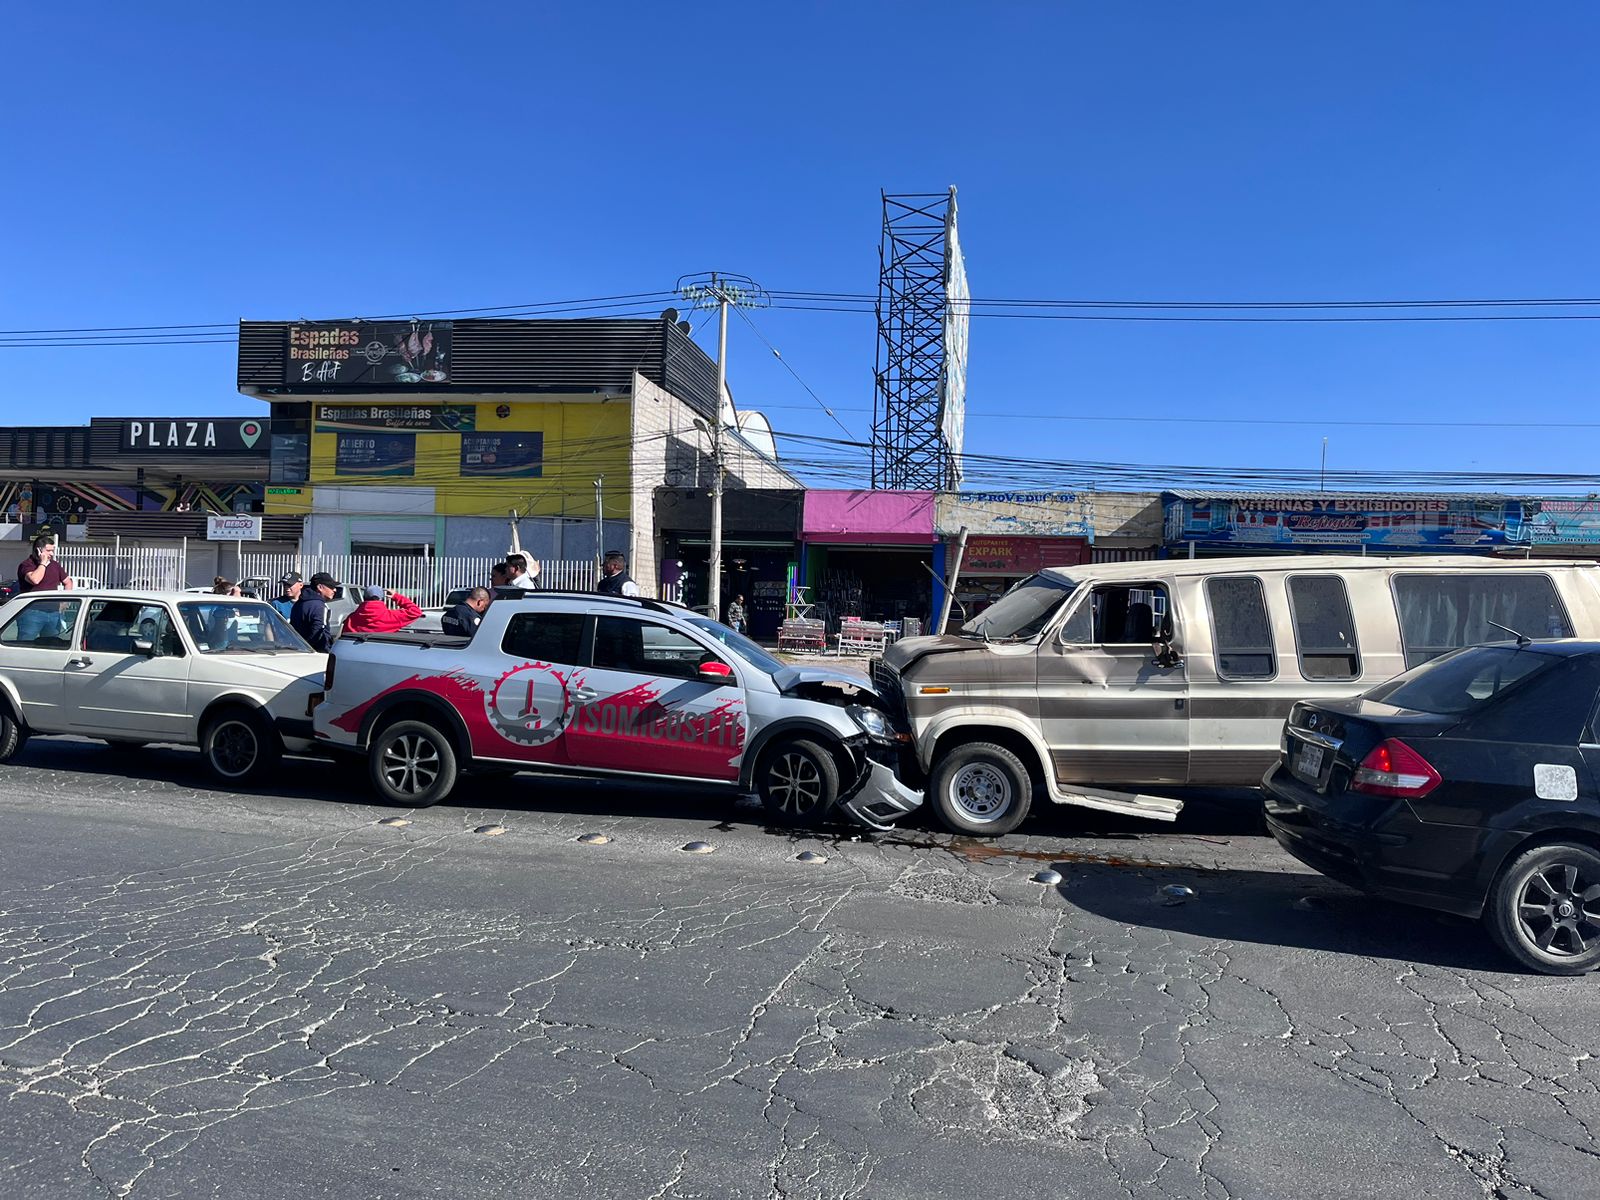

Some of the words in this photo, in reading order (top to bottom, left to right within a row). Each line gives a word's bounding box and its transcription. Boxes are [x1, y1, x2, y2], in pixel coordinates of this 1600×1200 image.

[290, 327, 360, 348] Espadas
[290, 347, 349, 360] Brasileñas
[320, 407, 367, 420] Espadas
[371, 406, 431, 419] Brasileñas
[130, 422, 216, 447] PLAZA
[1319, 501, 1330, 511] Y
[224, 519, 253, 529] BEBO'S
[969, 547, 1013, 556] EXPARK
